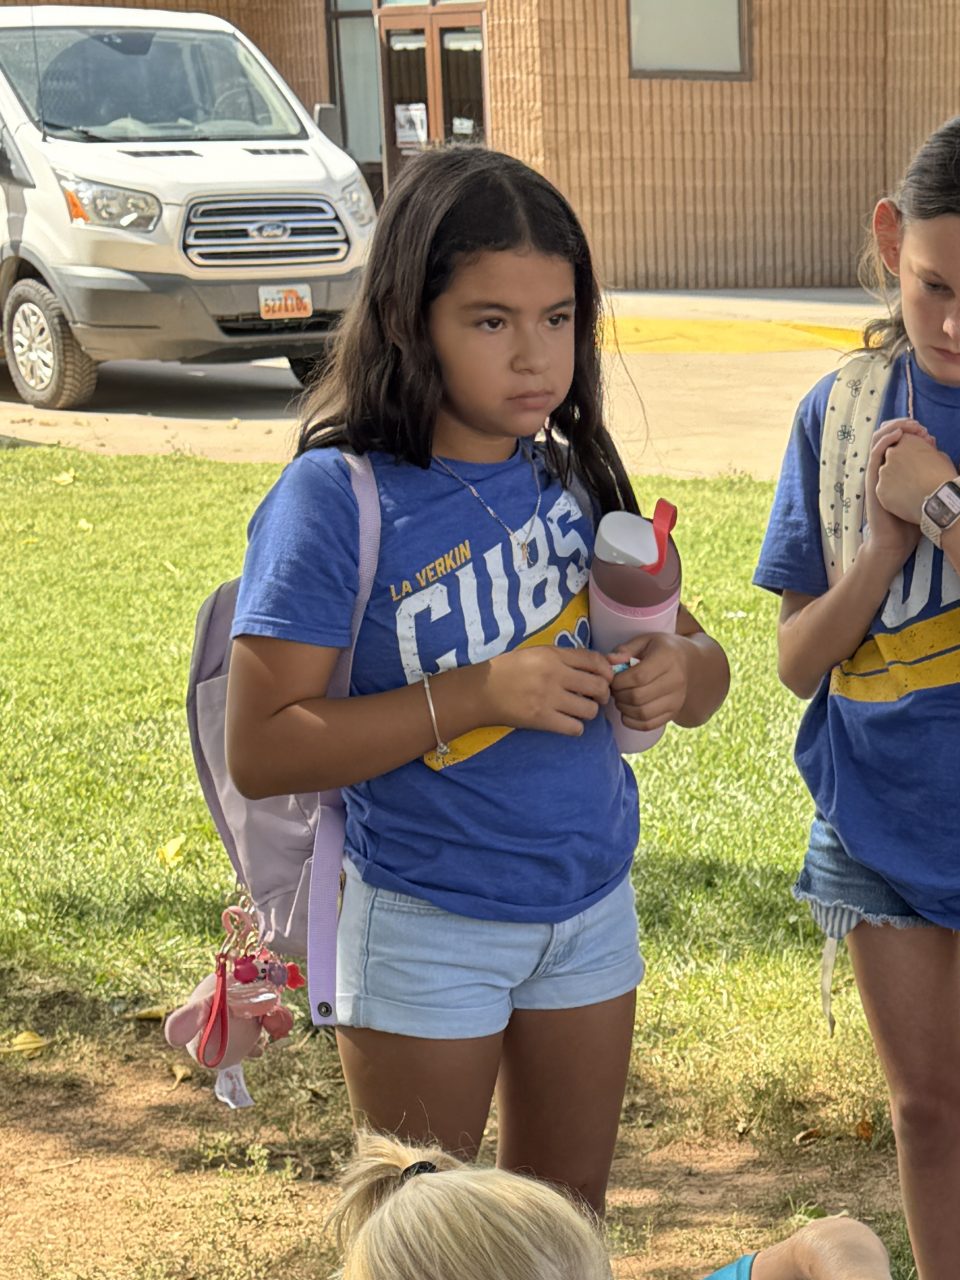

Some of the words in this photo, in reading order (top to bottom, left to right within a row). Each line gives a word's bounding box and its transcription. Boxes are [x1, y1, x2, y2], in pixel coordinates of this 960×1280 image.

[389, 583, 412, 602] LA
[416, 540, 472, 588] VERKIN
[395, 489, 590, 686] CUBS
